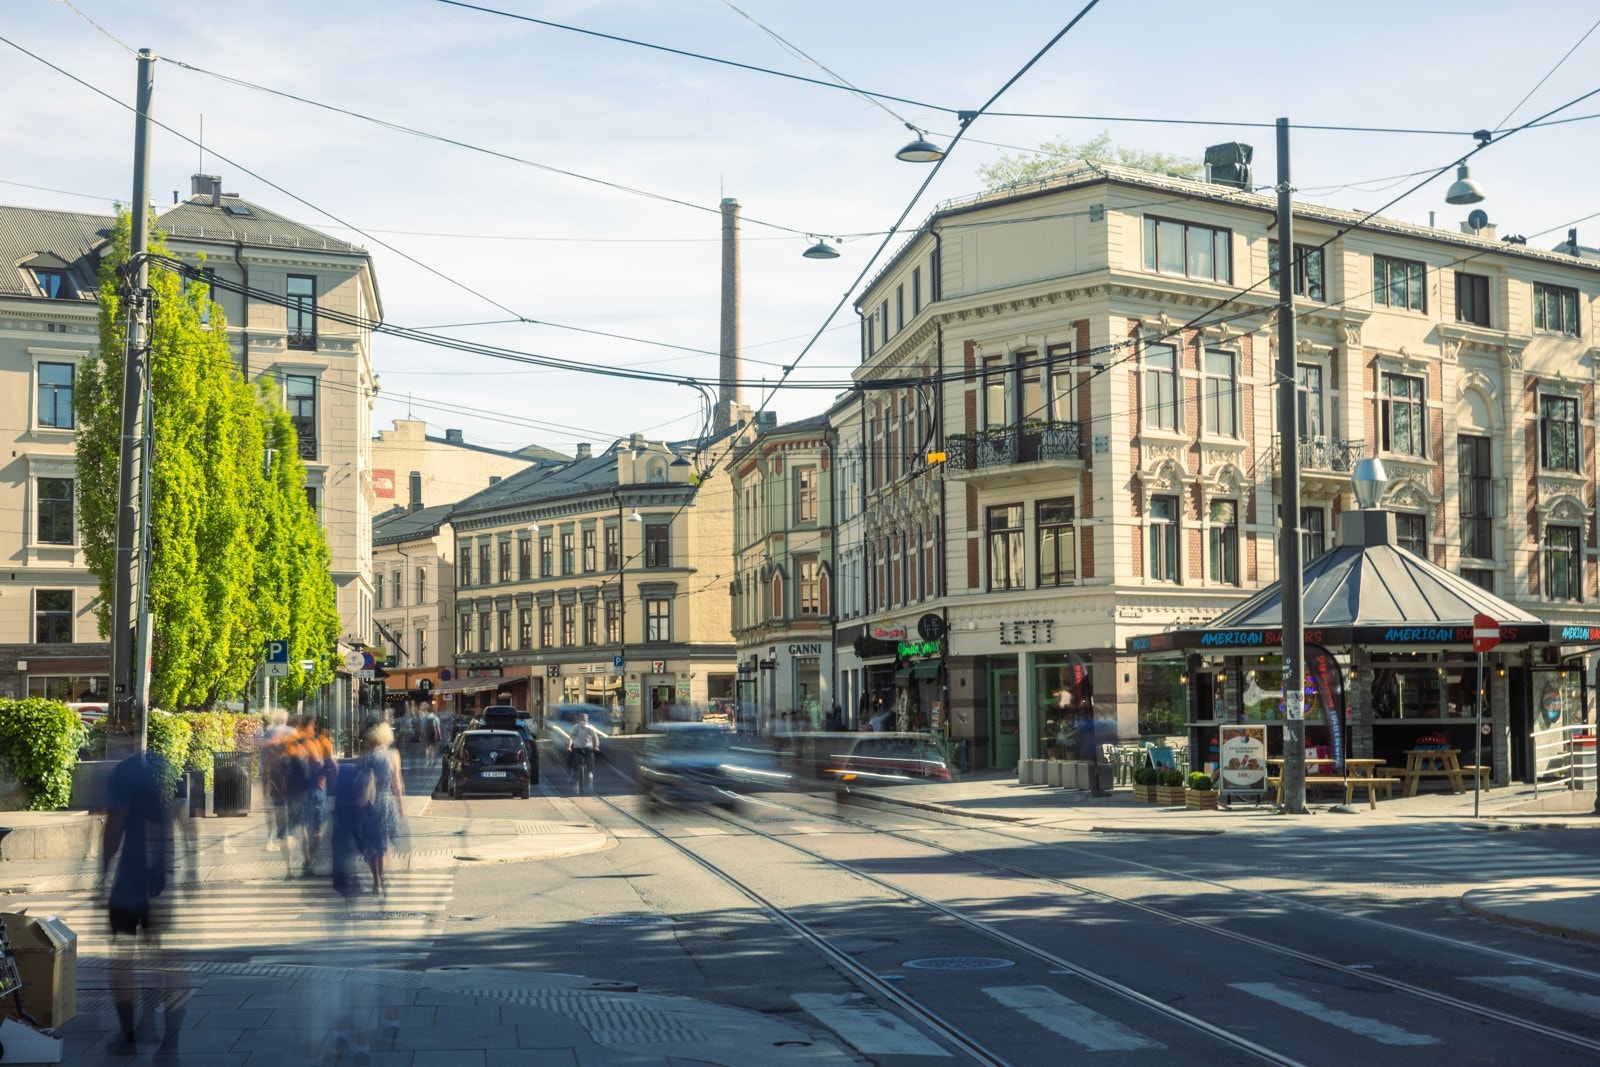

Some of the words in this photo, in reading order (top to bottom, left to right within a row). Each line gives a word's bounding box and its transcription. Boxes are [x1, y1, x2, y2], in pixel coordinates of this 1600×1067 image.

[1000, 619, 1054, 645] LETT
[1201, 631, 1263, 645] AMERICAN
[1265, 630, 1323, 644] BURS
[1384, 628, 1453, 641] AMERICAN
[1456, 627, 1517, 641] BURS
[1562, 627, 1590, 640] AMERICAN
[270, 643, 282, 661] P
[788, 644, 822, 654] GANNI
[616, 657, 622, 665] P
